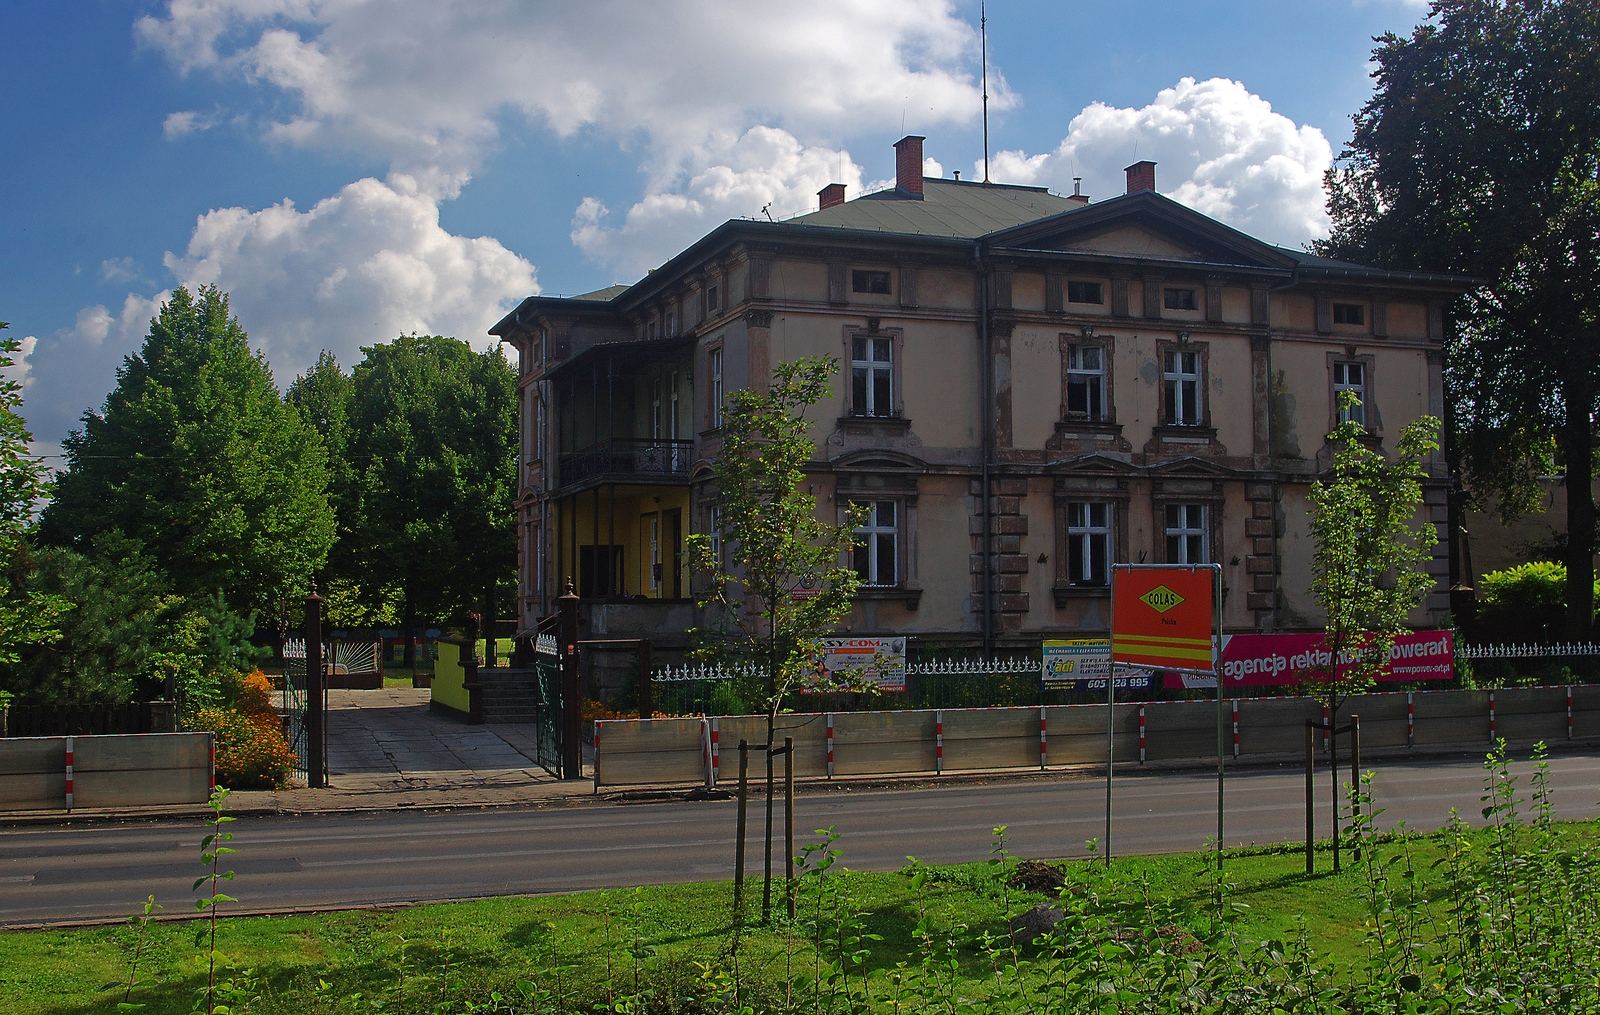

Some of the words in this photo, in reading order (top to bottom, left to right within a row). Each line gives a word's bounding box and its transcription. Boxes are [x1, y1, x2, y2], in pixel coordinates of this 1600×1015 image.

[1148, 593, 1175, 605] COLAS
[1224, 653, 1286, 680] agencja
[1087, 679, 1106, 688] 605
[1129, 678, 1149, 687] 995
